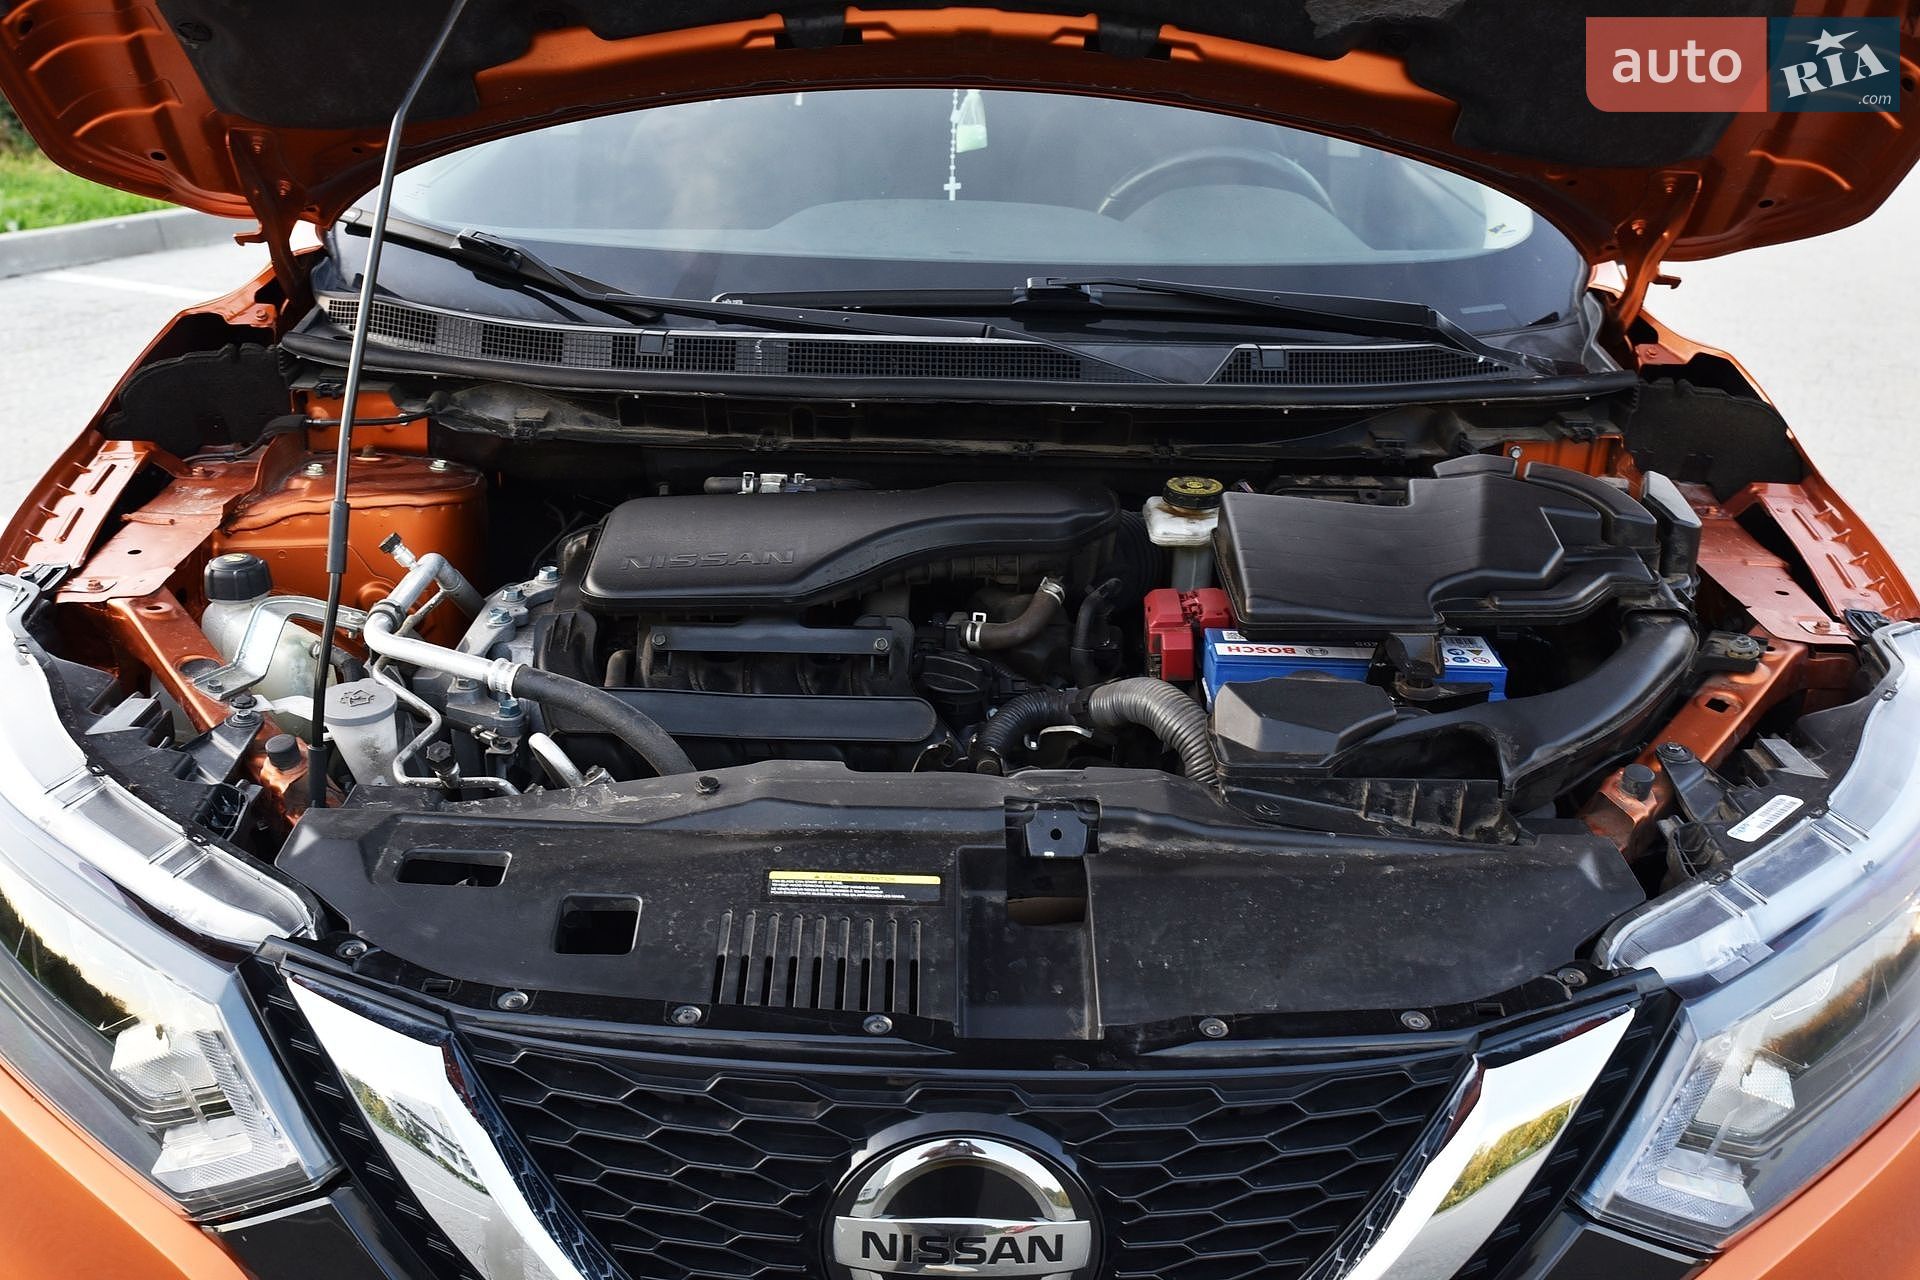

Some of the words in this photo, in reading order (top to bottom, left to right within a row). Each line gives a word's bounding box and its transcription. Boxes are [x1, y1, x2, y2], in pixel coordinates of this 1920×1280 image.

[620, 550, 795, 570] NISSAN
[1227, 646, 1296, 654] BOSCH
[861, 1230, 1064, 1265] NISSAN
